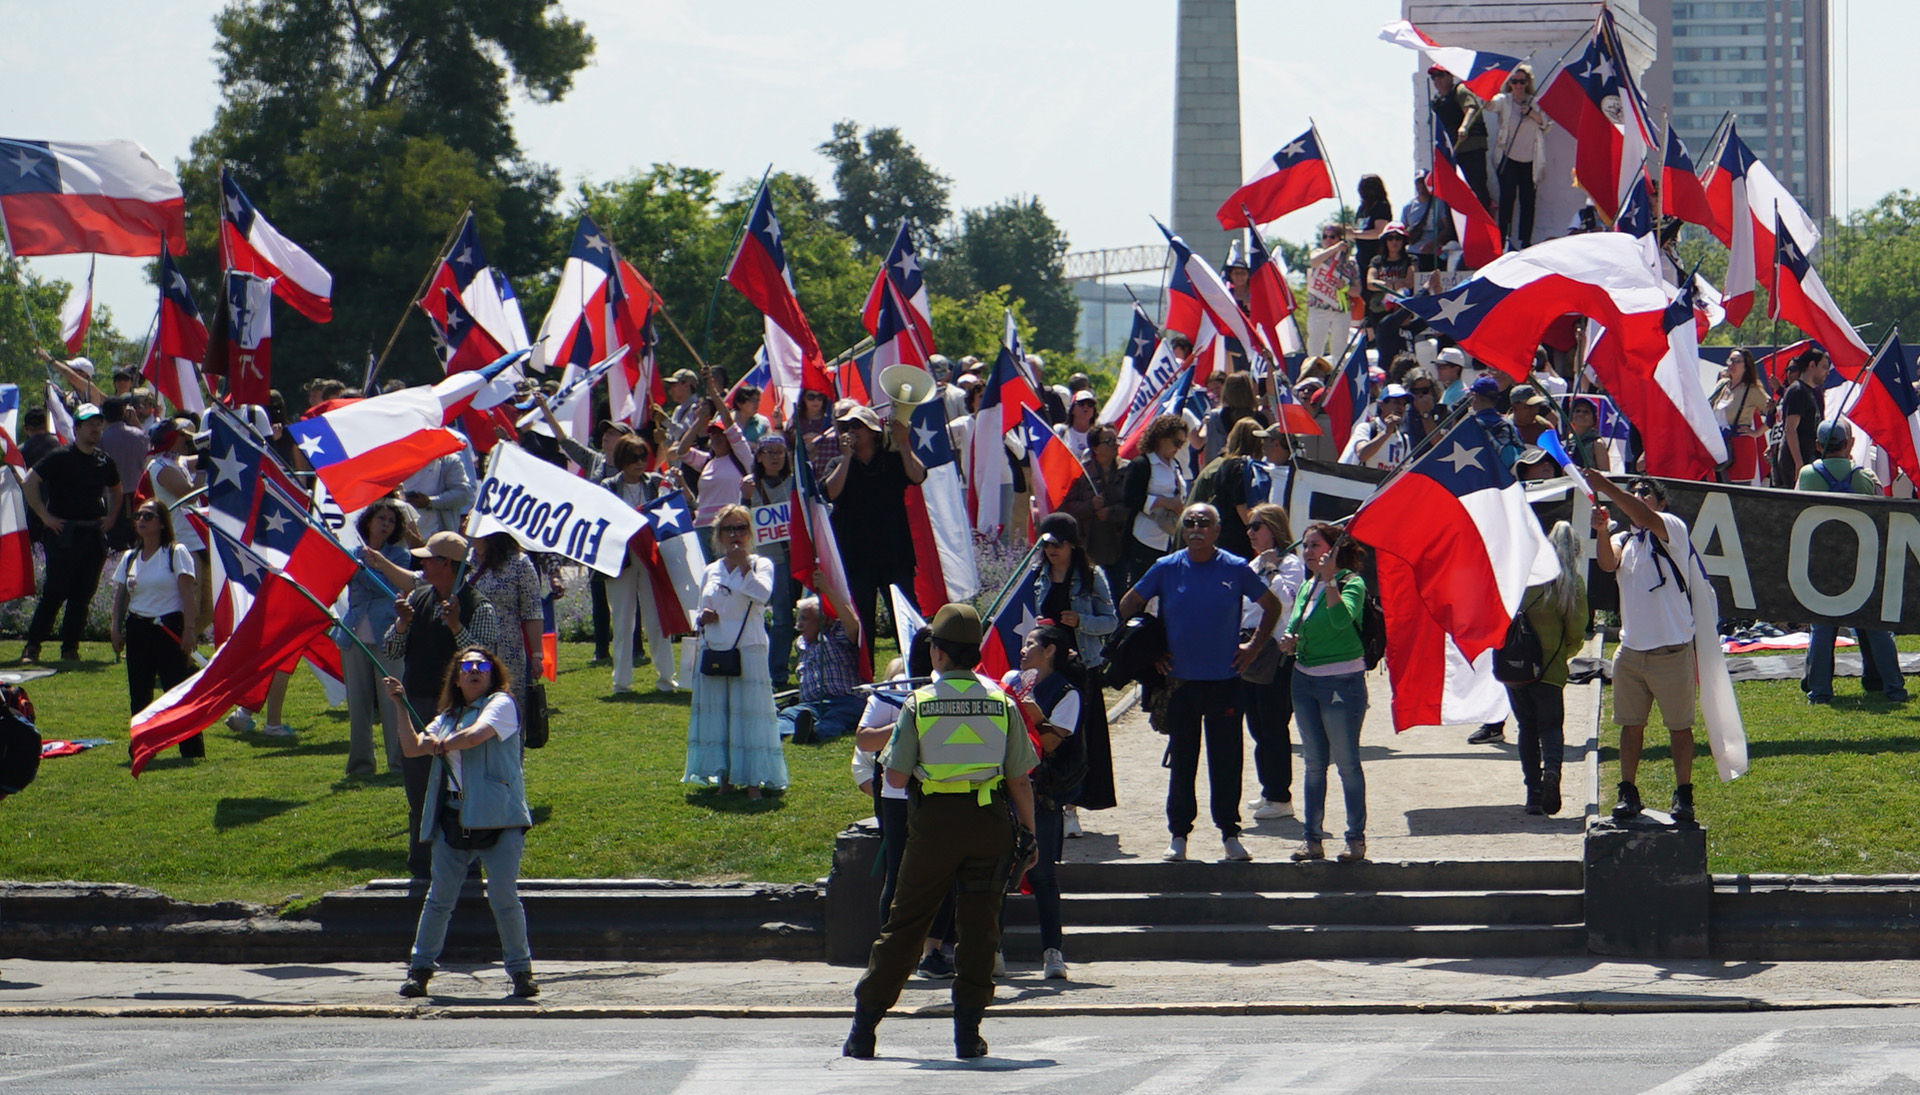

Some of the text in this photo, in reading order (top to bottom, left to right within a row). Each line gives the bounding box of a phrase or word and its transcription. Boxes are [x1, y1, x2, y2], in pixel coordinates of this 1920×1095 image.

[757, 524, 790, 543] FUE
[921, 701, 1003, 715] CARABINEROS DE CHILE
